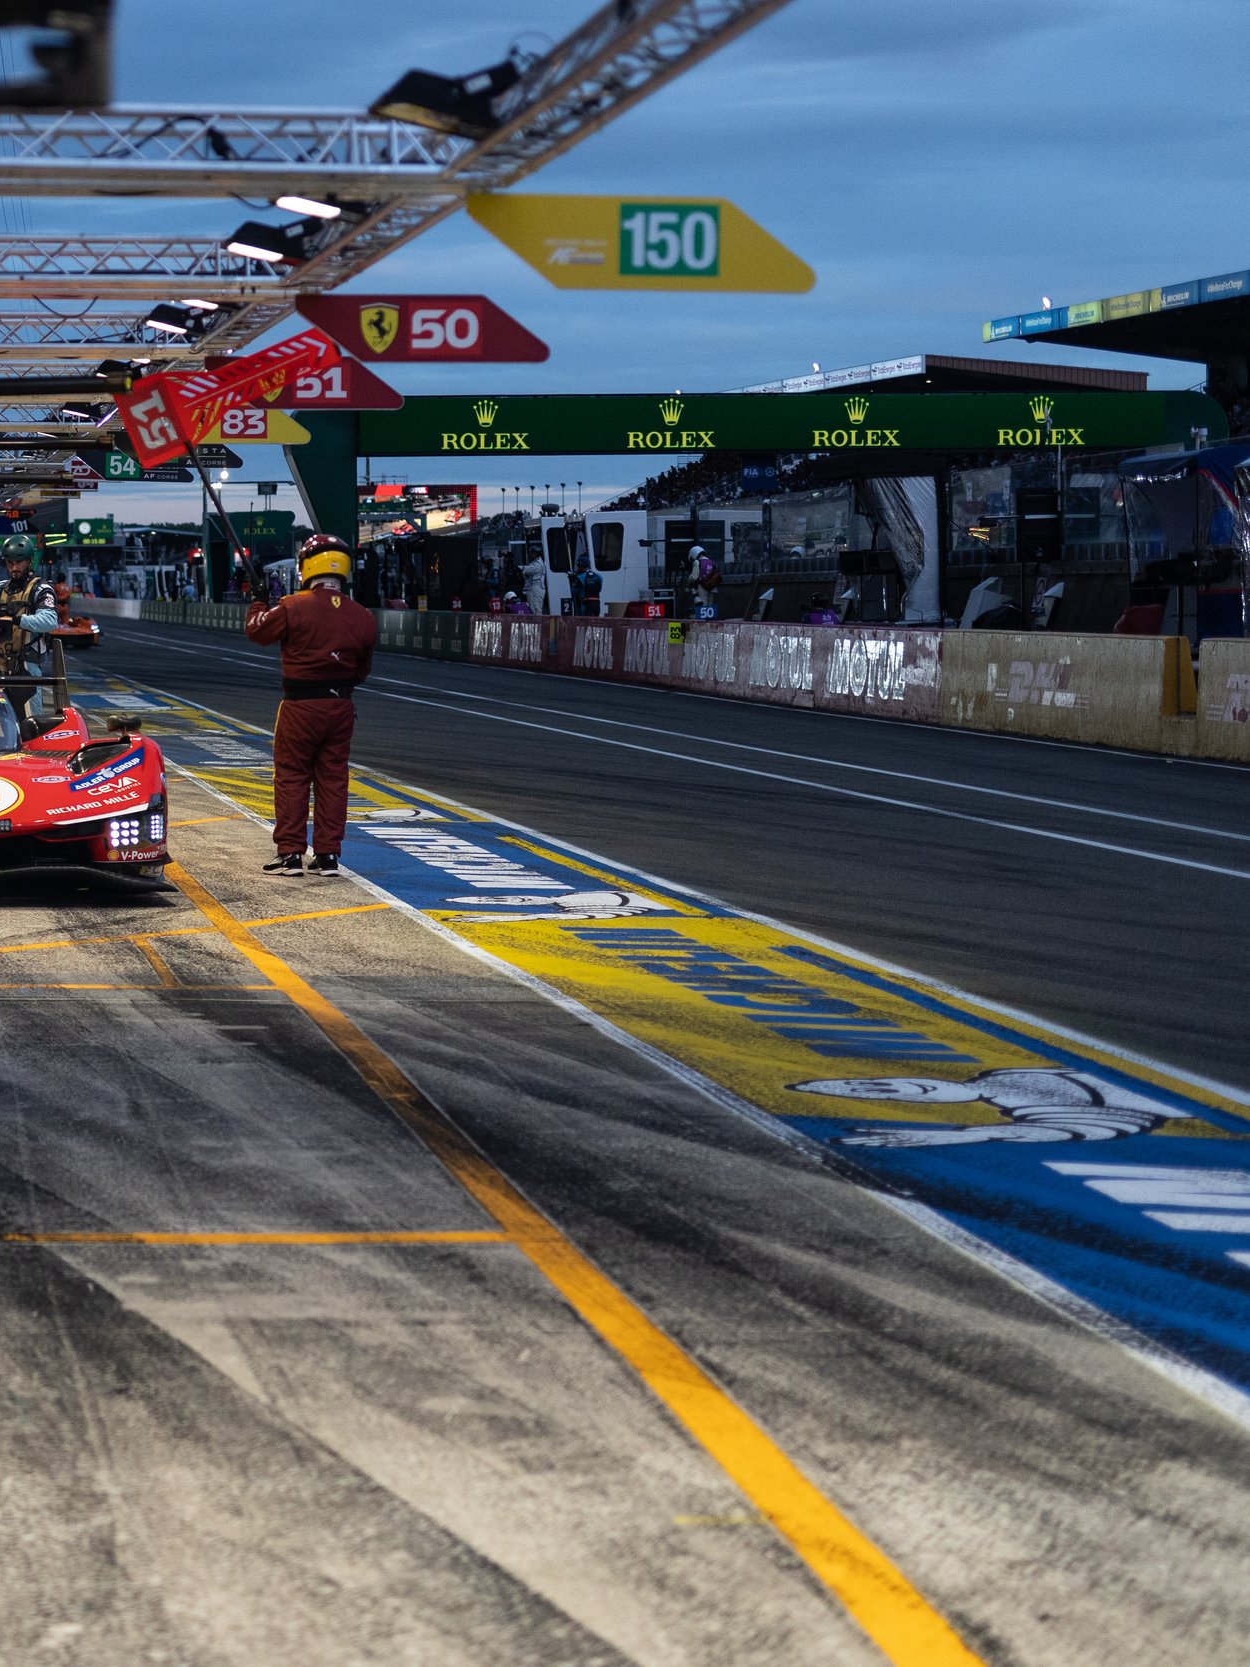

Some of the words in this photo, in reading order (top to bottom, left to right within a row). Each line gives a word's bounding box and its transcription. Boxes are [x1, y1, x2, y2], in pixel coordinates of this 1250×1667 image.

[622, 211, 718, 270] 150
[1166, 291, 1190, 303] MICHELIN
[410, 308, 480, 349] 50
[296, 367, 348, 398] 51
[130, 389, 179, 450] 51
[222, 408, 266, 435] 83
[441, 432, 530, 450] ROLEX
[627, 431, 716, 448] ROLEX
[812, 429, 900, 447] ROLEX
[997, 428, 1085, 446] ROLEX
[109, 455, 136, 475] 54
[743, 466, 759, 477] FIA
[11, 520, 29, 533] 101
[564, 601, 570, 612] 2
[647, 606, 661, 617] 51
[700, 607, 714, 618] 50
[573, 625, 614, 670] MOTUL
[623, 628, 671, 676] MOTUL
[681, 631, 736, 682] MOTUL
[749, 634, 813, 690] MOTUL
[827, 638, 906, 701] MOTUL
[75, 776, 106, 790] ADLER
[113, 758, 141, 773] GROUP
[115, 782, 142, 793] LOGISTICS
[46, 801, 103, 815] RICHARD
[103, 791, 140, 805] MILLE
[121, 850, 160, 860] V-Power
[559, 926, 983, 1063] MICHELIN
